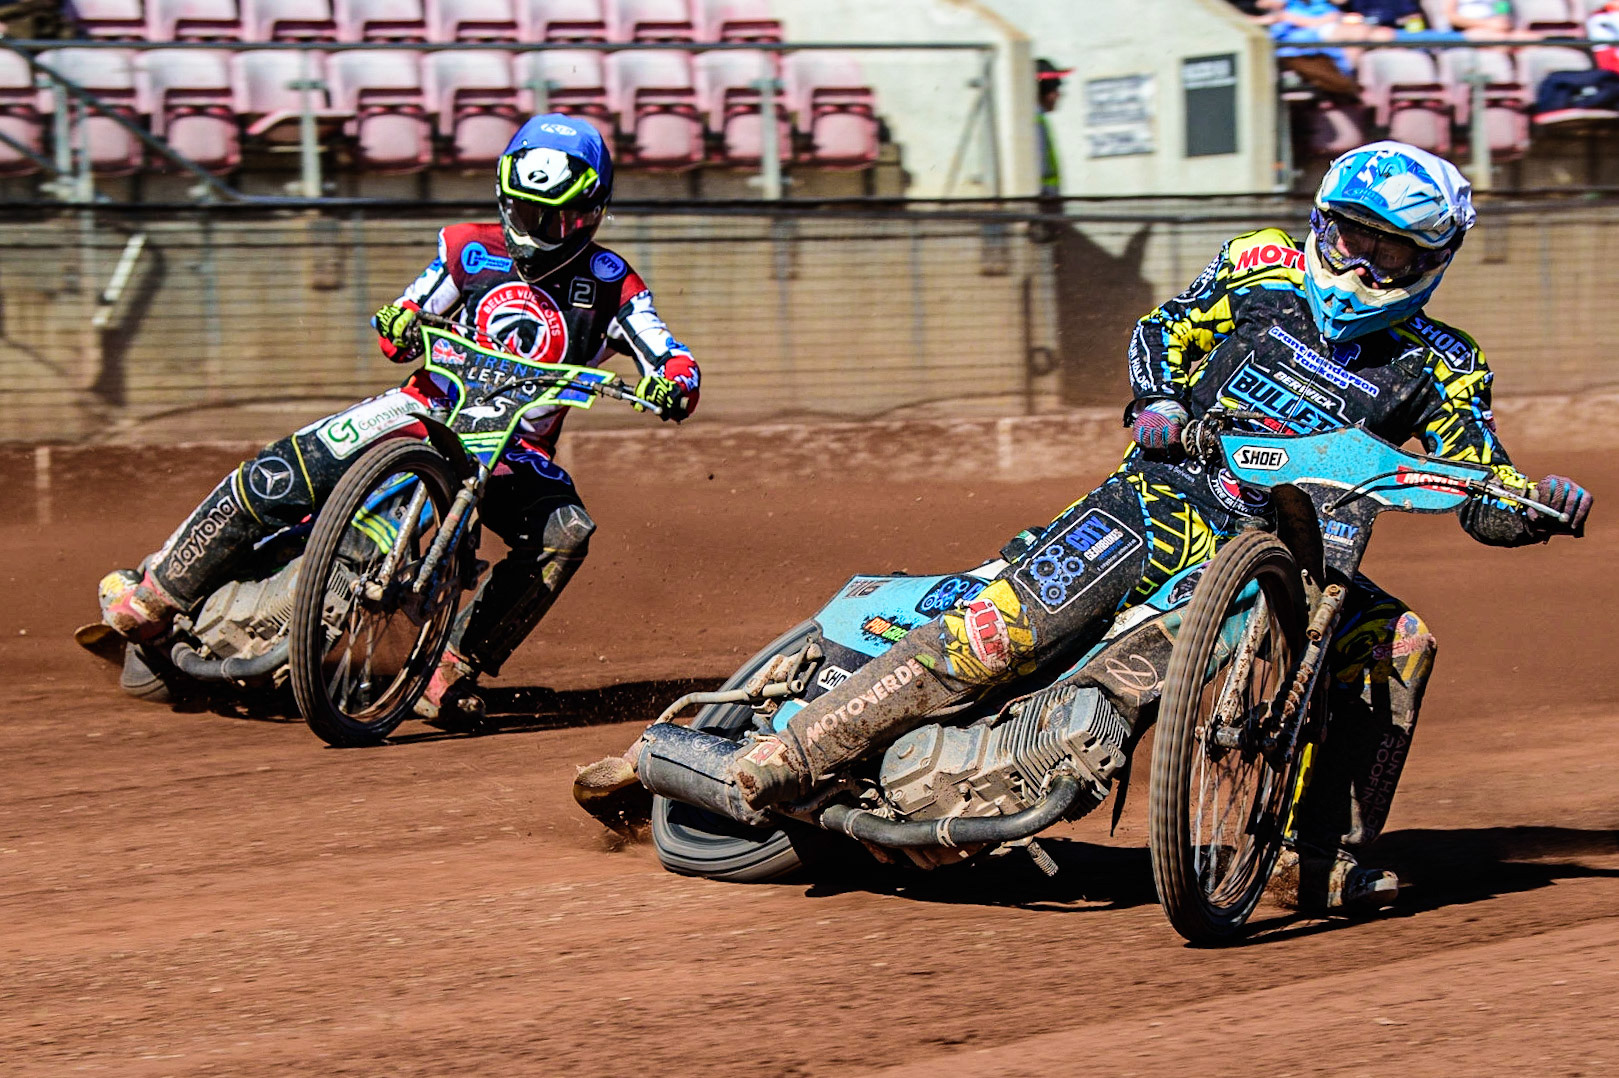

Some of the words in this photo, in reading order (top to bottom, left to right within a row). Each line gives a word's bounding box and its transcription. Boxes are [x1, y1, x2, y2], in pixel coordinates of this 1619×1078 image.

[483, 290, 515, 314] BELLE
[516, 289, 540, 304] VUE
[539, 301, 562, 337] COLTS
[574, 283, 591, 304] 2
[474, 353, 544, 378] TRENT
[1270, 327, 1306, 356] Grant
[1305, 350, 1379, 397] Henderson
[1293, 351, 1350, 390] Tankers
[1273, 370, 1337, 411] BERWICK
[1240, 449, 1283, 466] SHOEI
[169, 495, 237, 578] daytona
[1066, 515, 1113, 552] CITY
[1325, 520, 1360, 539] CITY
[805, 656, 923, 746] MOTOVERDE
